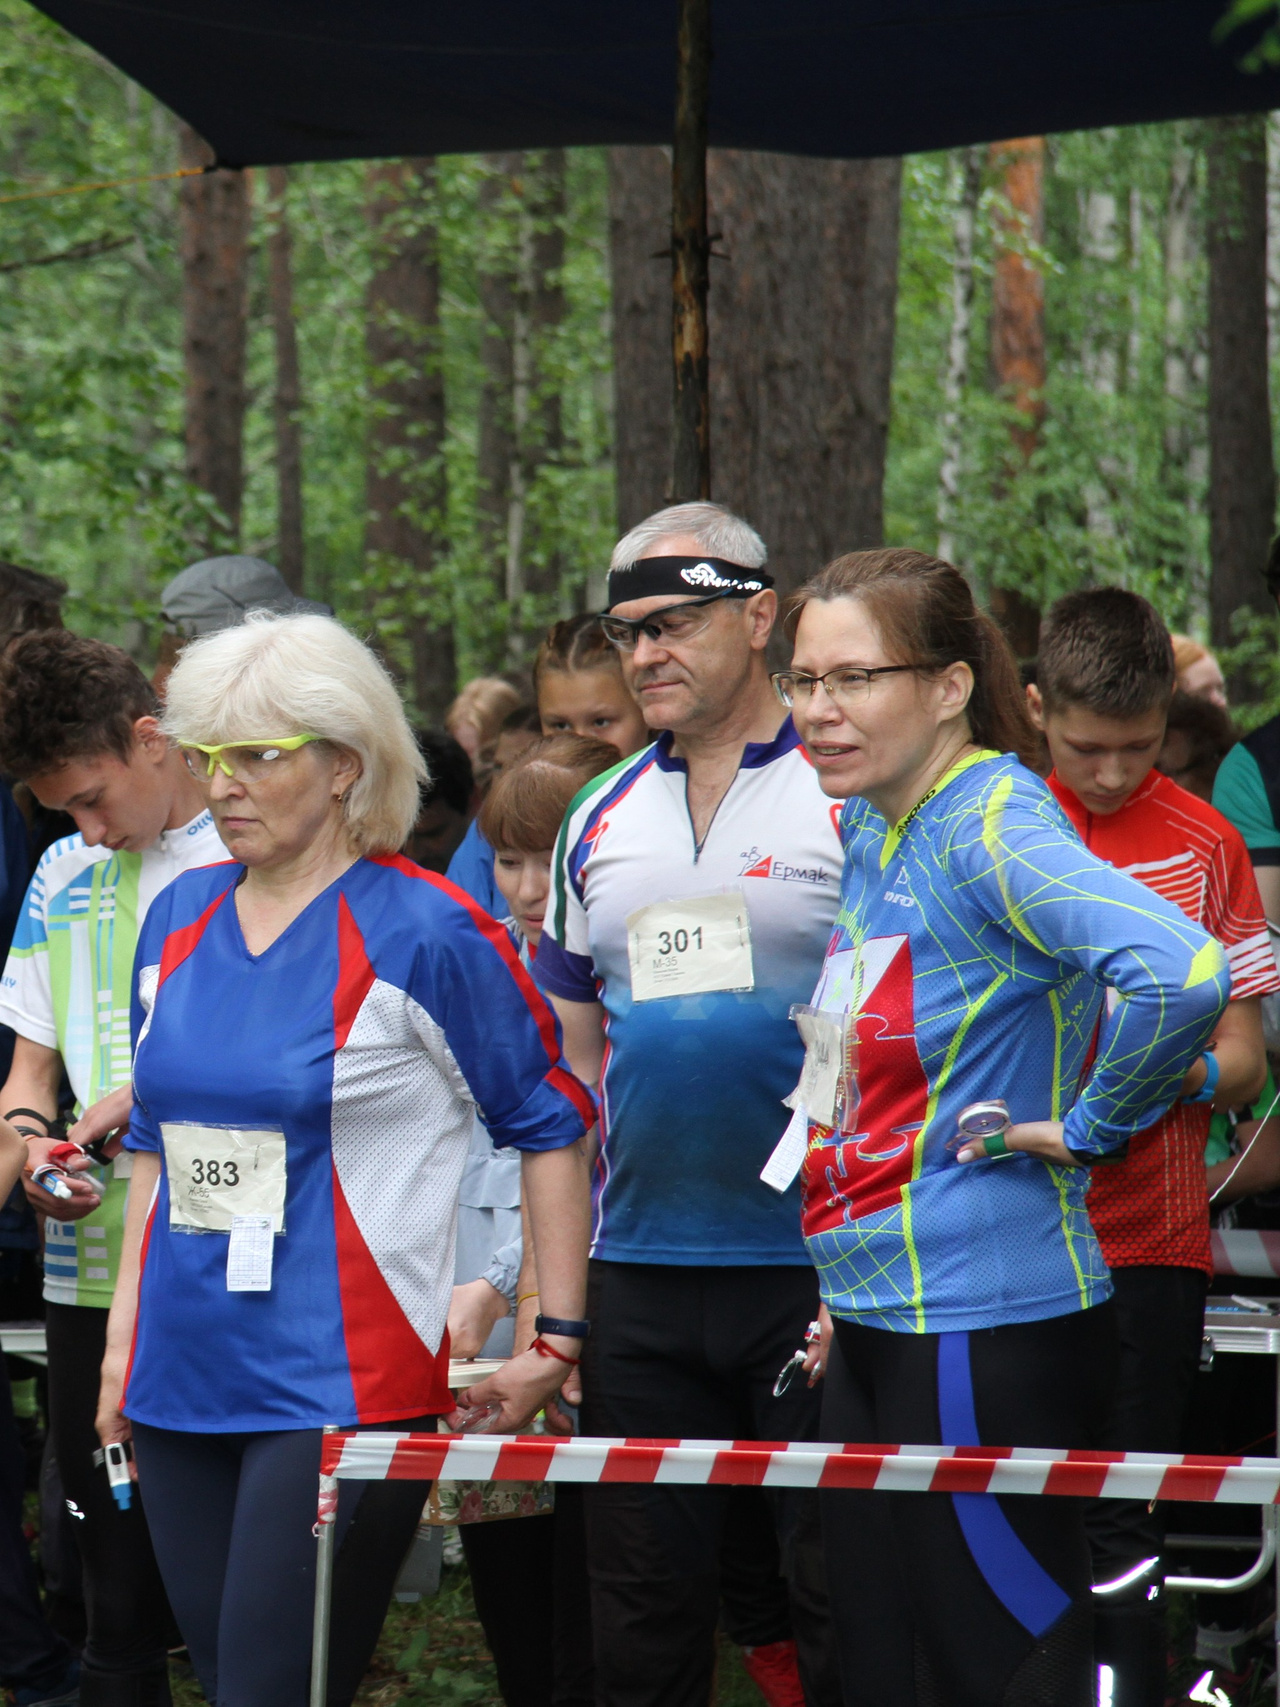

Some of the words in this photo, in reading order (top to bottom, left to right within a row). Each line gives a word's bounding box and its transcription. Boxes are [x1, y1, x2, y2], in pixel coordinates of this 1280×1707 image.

[772, 861, 828, 883] Ермак
[658, 926, 703, 955] 301
[191, 1158, 240, 1187] 383
